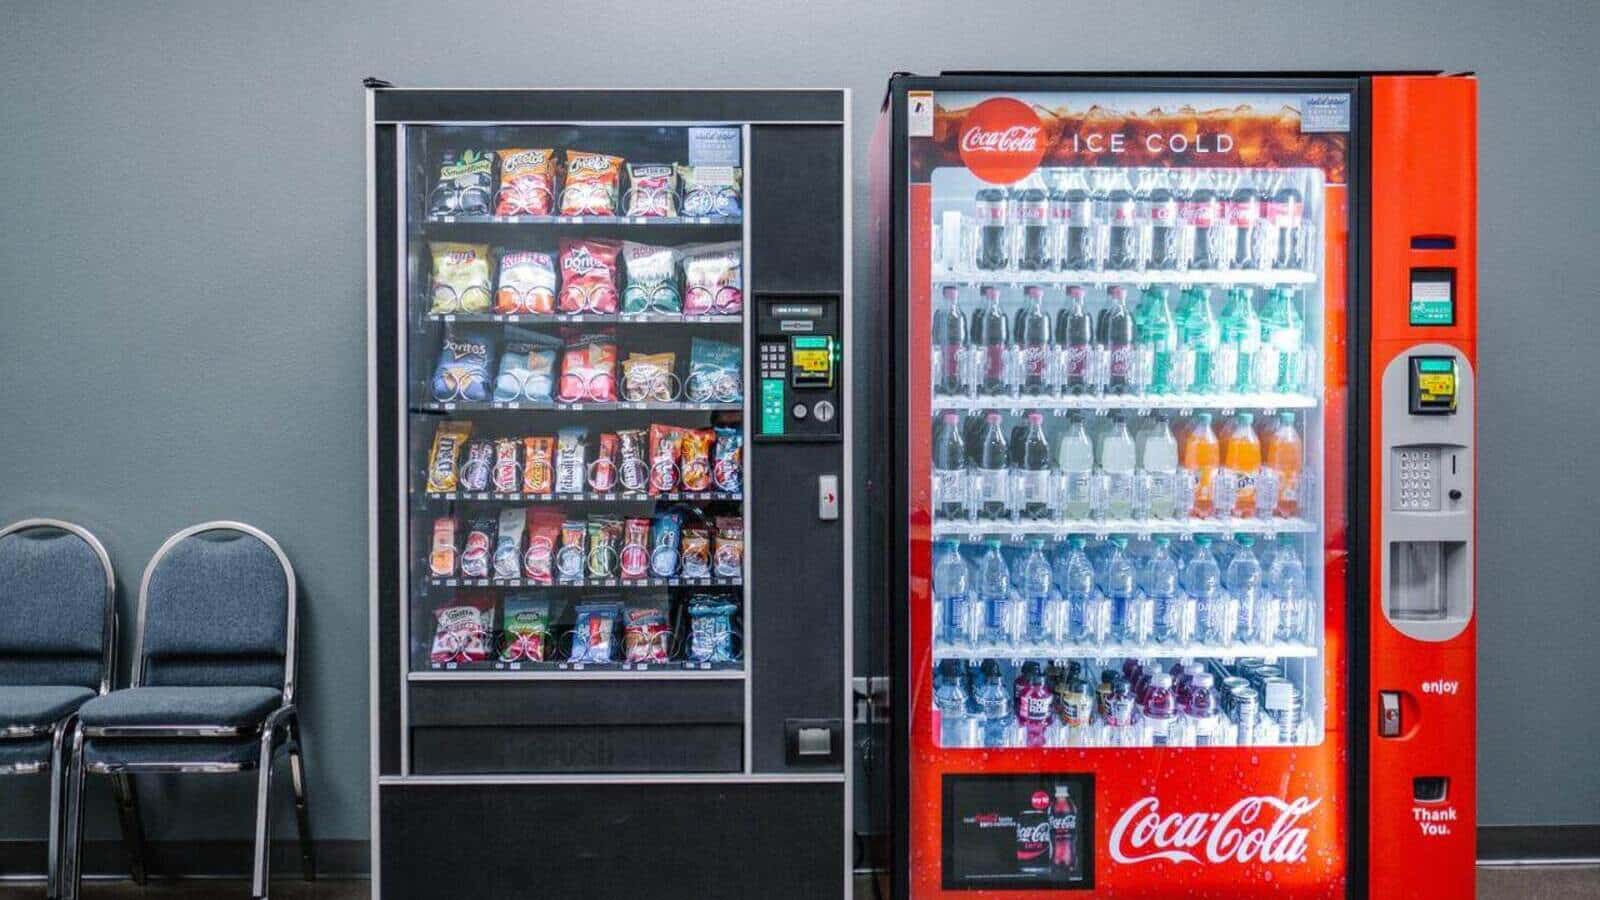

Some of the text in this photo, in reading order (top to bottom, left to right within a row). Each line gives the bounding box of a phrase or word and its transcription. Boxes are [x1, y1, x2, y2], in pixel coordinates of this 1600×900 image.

[961, 125, 1041, 153] Coca-Cola
[1073, 134, 1234, 154] ICE COLD
[1421, 680, 1459, 695] enjoy
[1412, 807, 1457, 821] Thank
[1108, 795, 1323, 865] Coca-Cola
[1420, 822, 1451, 836] You.
